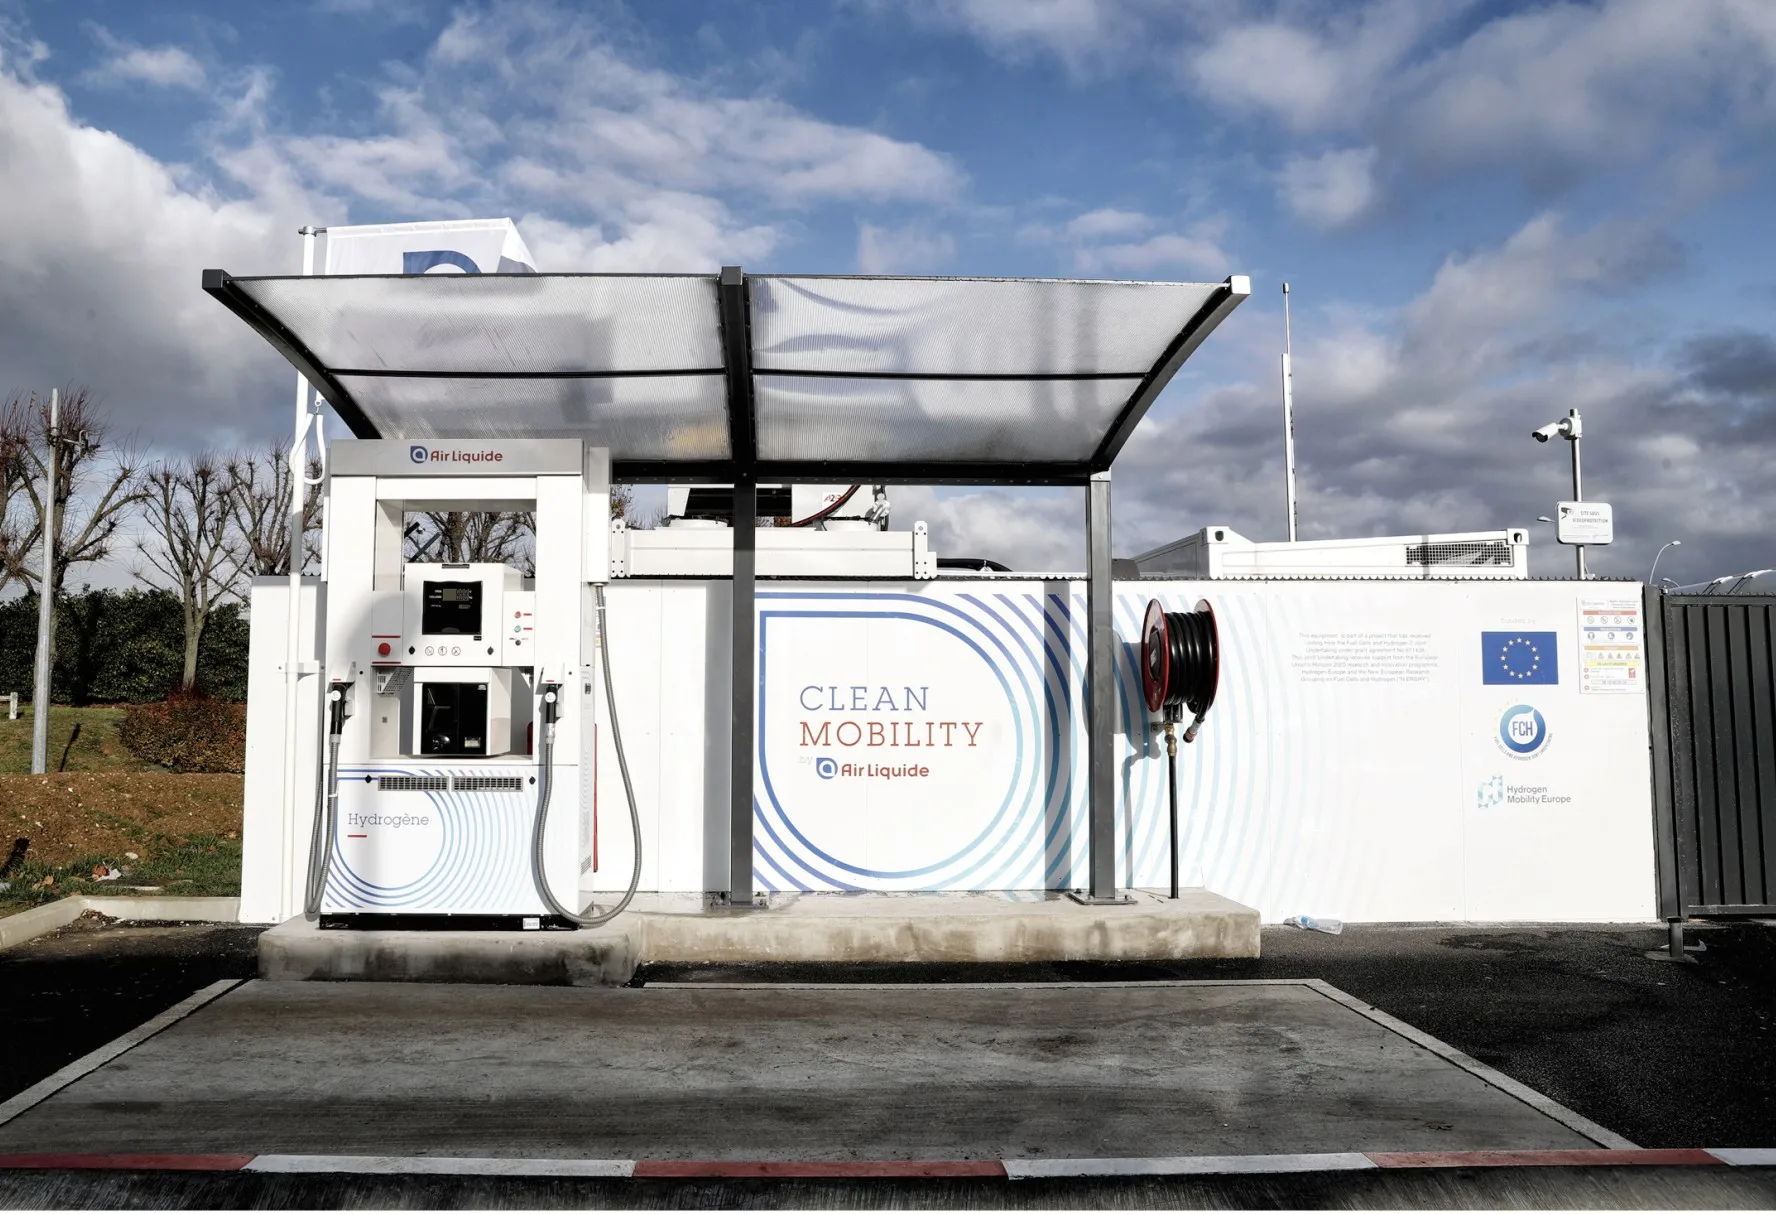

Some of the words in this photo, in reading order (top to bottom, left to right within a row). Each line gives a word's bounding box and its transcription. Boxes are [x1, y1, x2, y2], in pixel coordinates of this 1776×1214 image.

[430, 450, 450, 462] Air
[452, 450, 503, 464] Liquide
[800, 685, 929, 711] CLEAN
[799, 721, 983, 747] MOBILITY
[1512, 721, 1533, 736] FCH
[841, 763, 865, 778] Air
[867, 763, 930, 780] Liquide
[1507, 785, 1548, 795] Hydrogen
[1508, 795, 1540, 804] Mobility
[1542, 795, 1572, 804] Europe
[348, 812, 429, 828] Hydrogène
